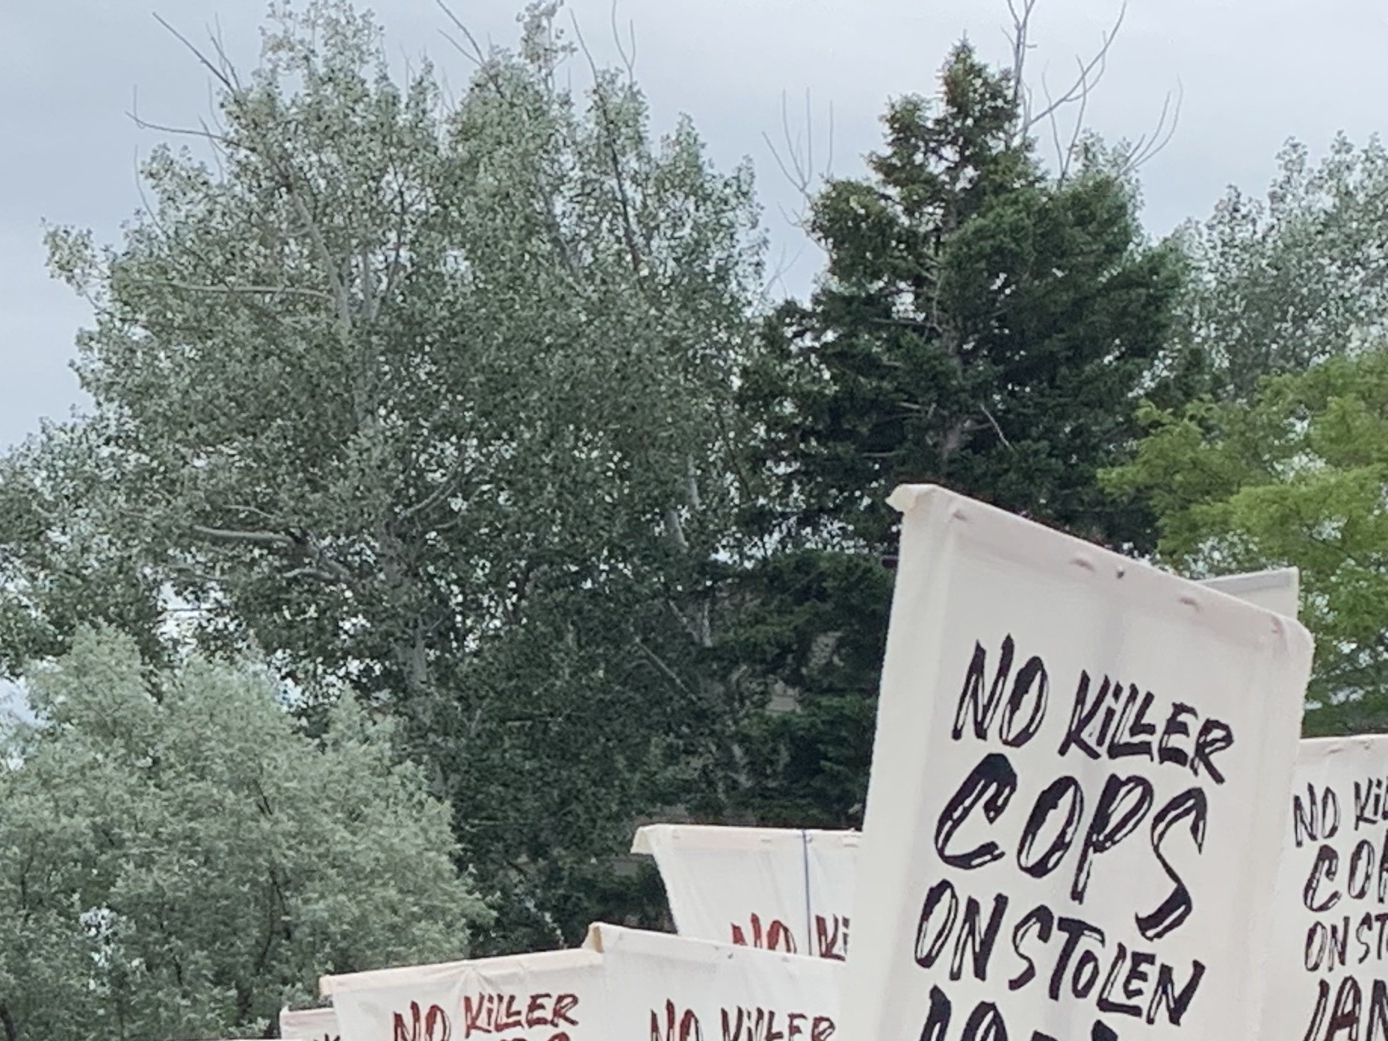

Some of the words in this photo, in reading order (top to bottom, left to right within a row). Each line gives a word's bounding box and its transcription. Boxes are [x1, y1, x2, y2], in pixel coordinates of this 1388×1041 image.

[951, 634, 1049, 748] NO
[933, 752, 1208, 940] COPS
[1293, 782, 1340, 847] NO
[1303, 831, 1388, 912] CO
[914, 878, 1009, 981] ON
[1009, 905, 1206, 1026] STOLEN
[1304, 916, 1350, 972] ON
